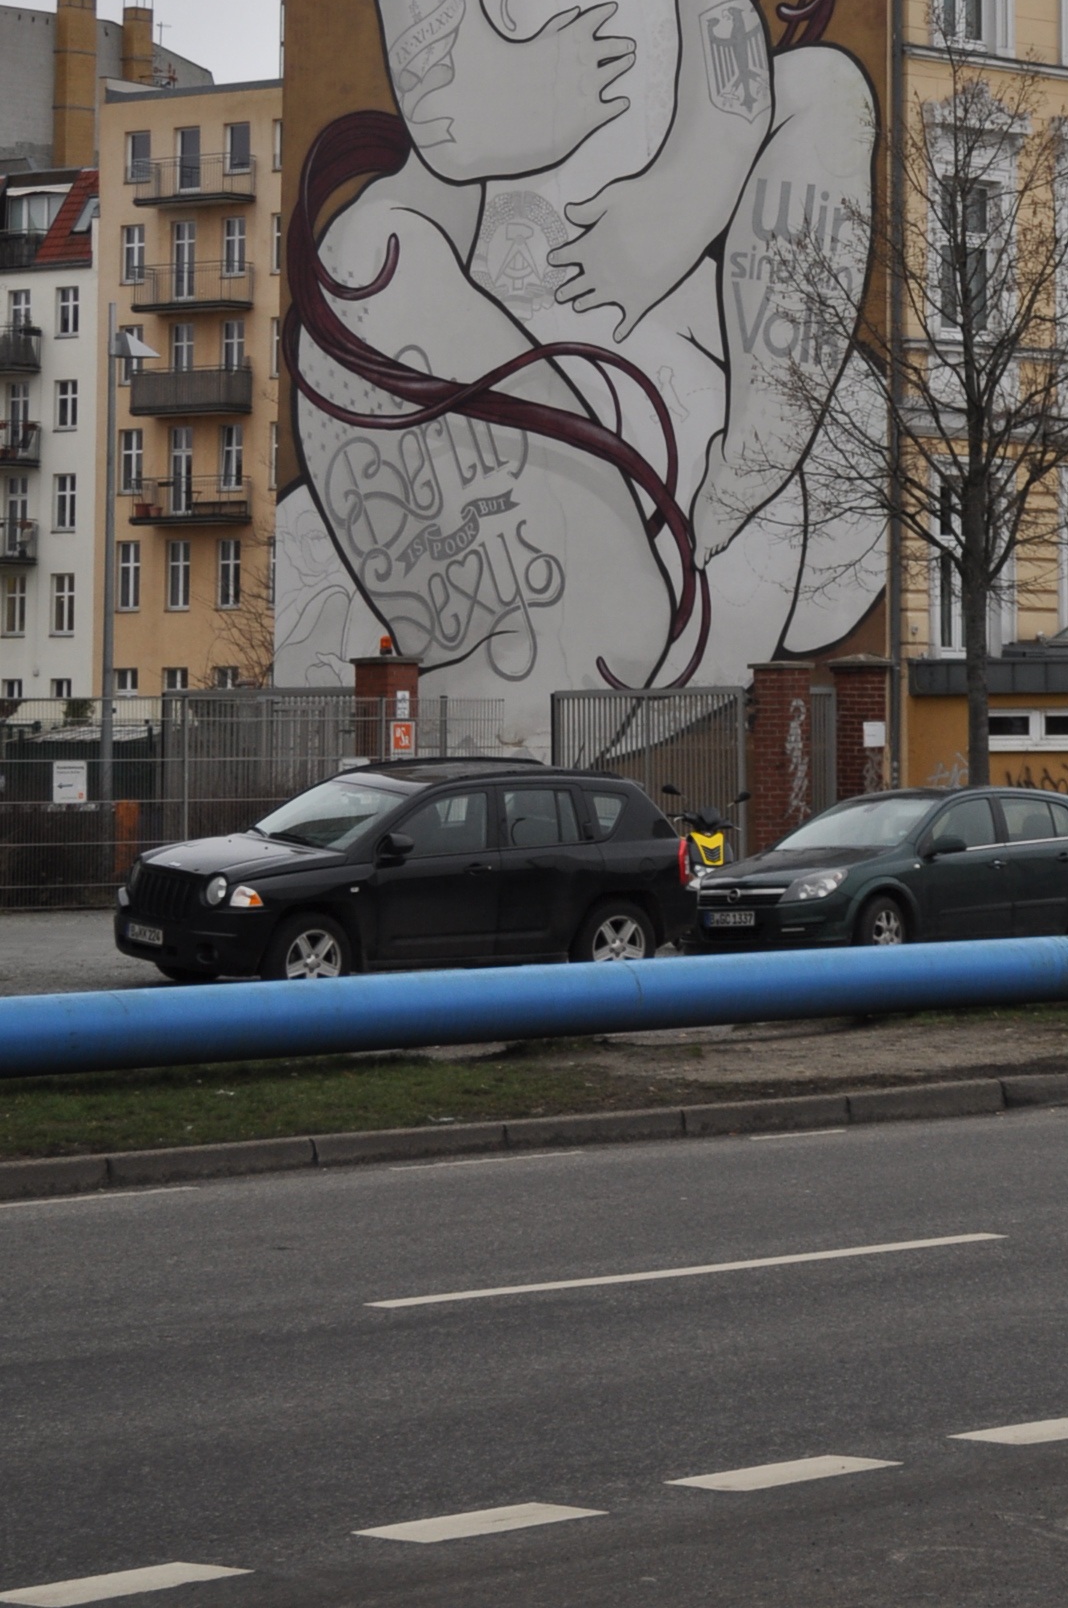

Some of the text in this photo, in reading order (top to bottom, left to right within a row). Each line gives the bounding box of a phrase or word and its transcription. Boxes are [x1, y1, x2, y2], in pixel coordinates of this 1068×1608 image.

[751, 177, 853, 253] Wir
[407, 499, 507, 562] IS POOR BUT
